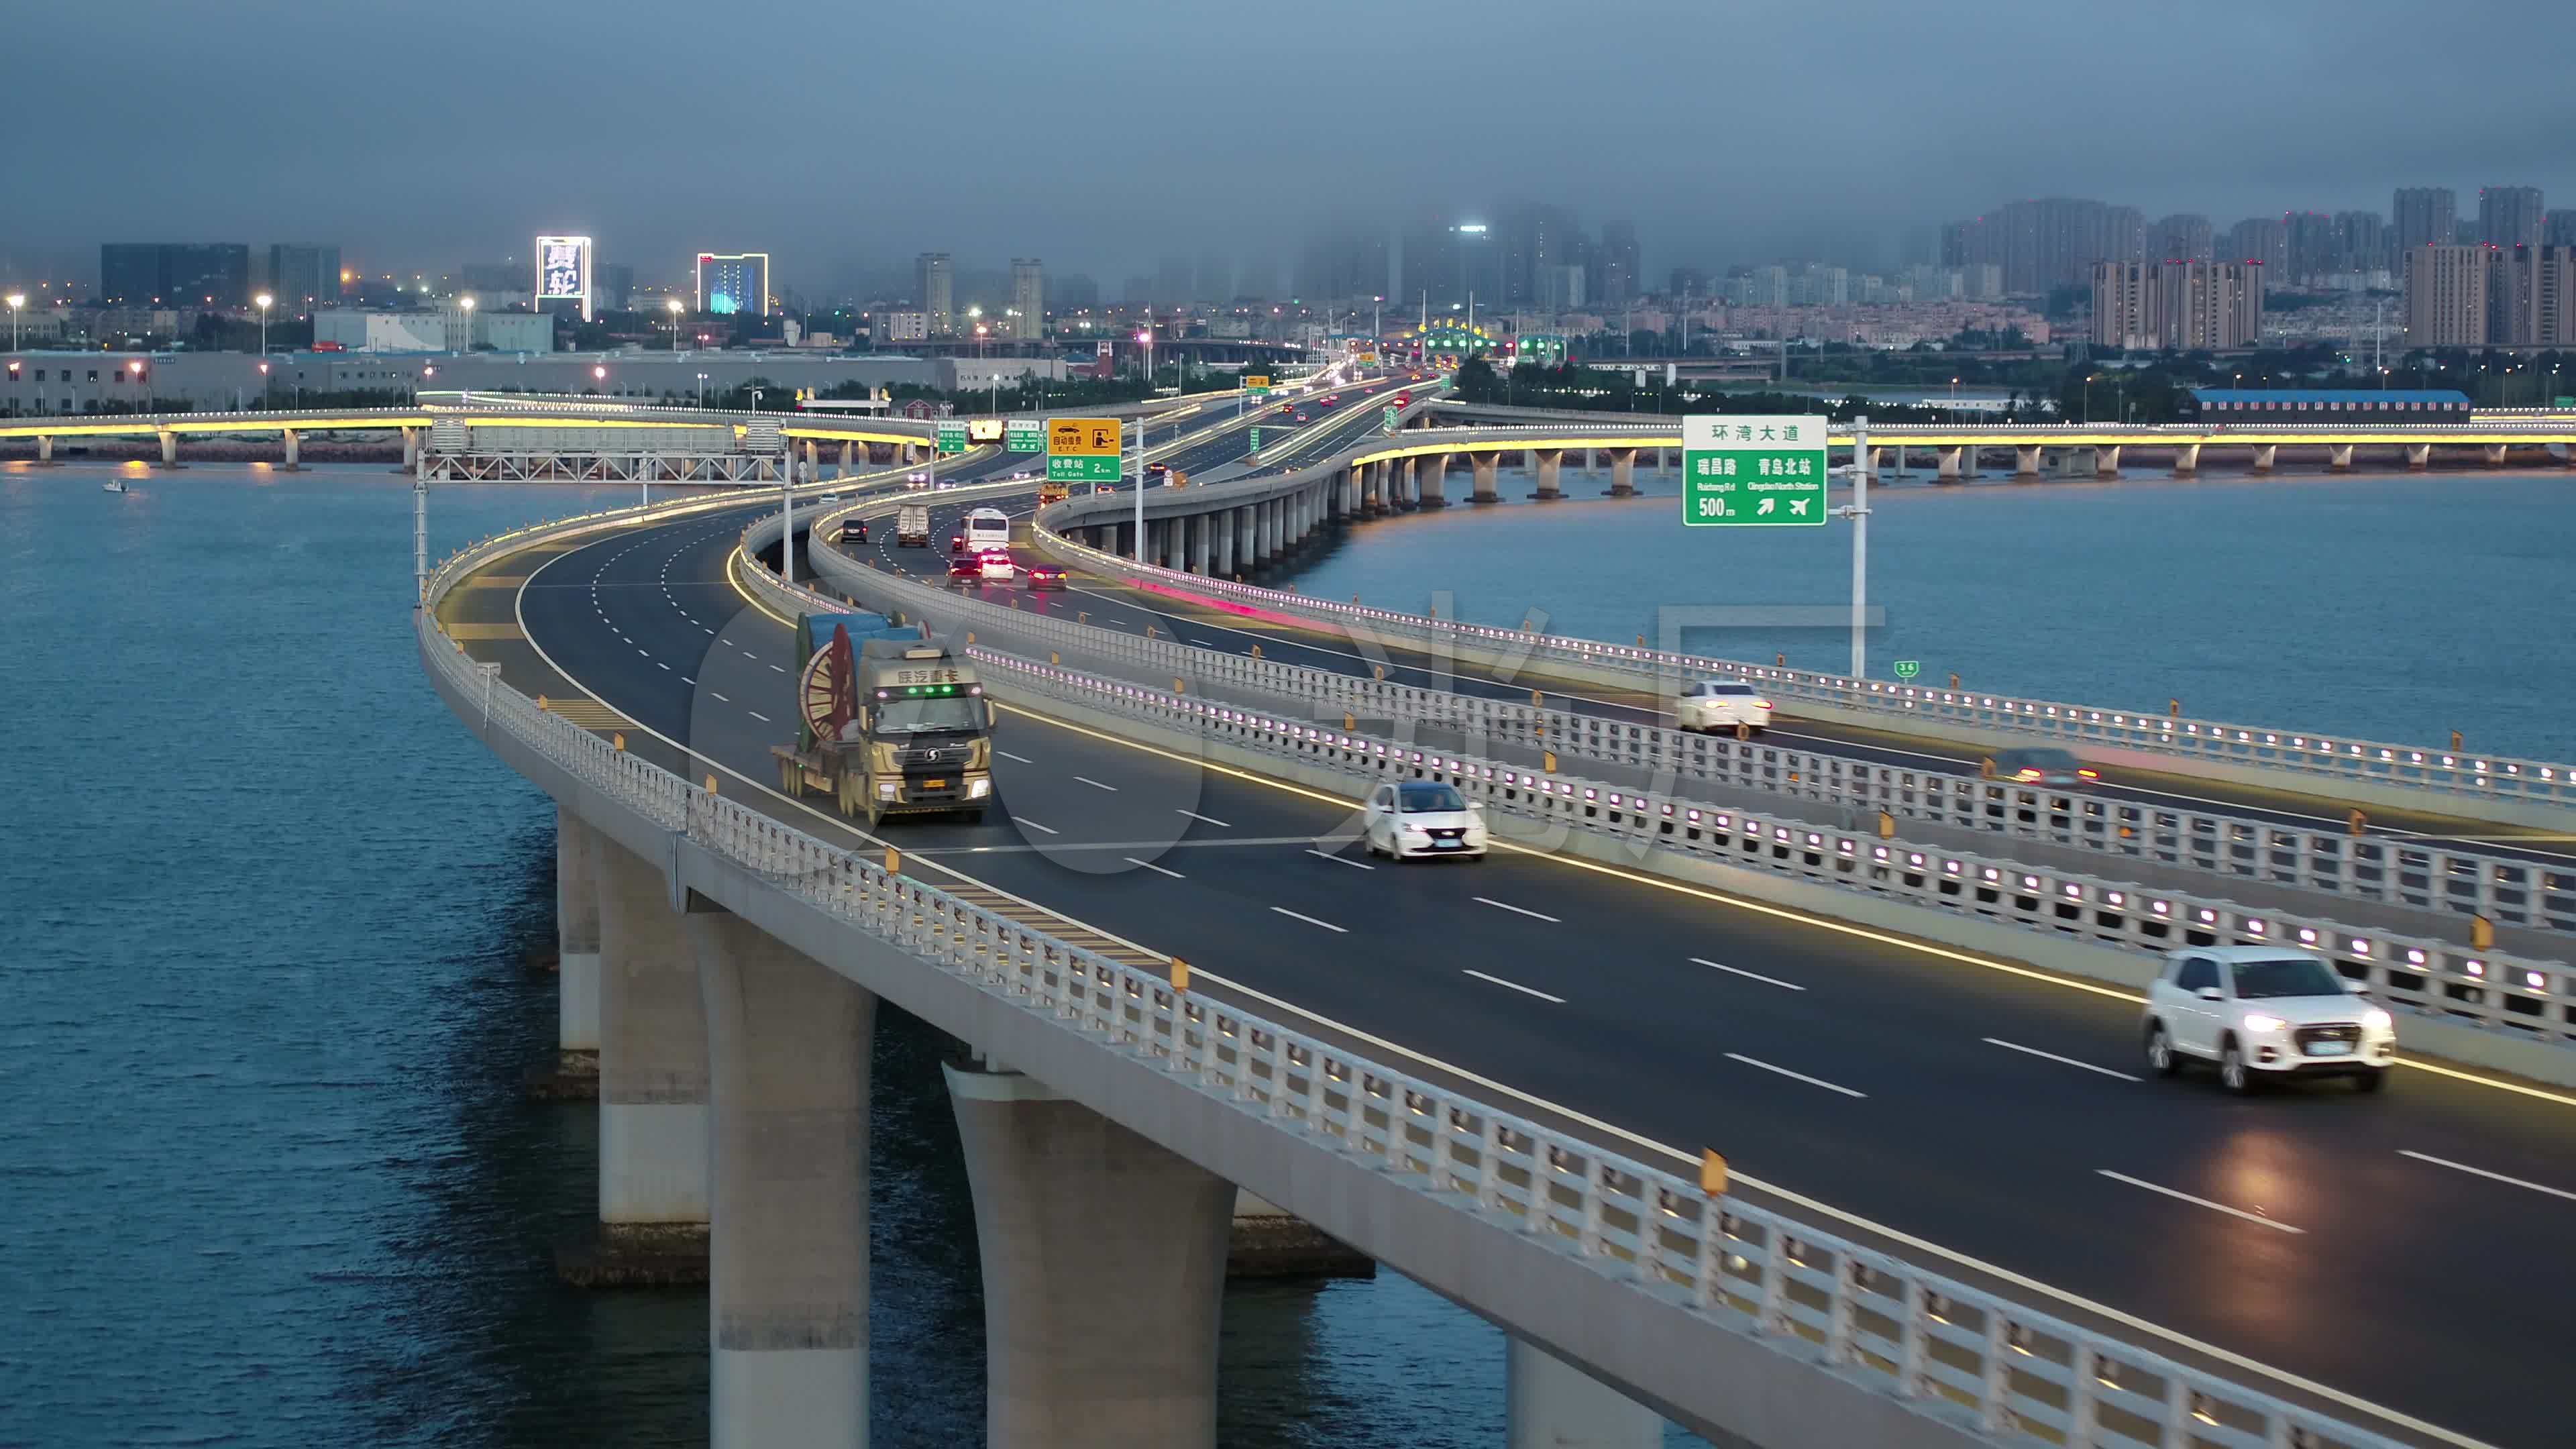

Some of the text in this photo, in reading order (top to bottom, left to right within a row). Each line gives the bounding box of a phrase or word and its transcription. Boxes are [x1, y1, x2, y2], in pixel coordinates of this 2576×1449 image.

[1711, 425, 1799, 441] 环湾大道
[1052, 459, 1084, 469] 收费站
[1697, 458, 1736, 476] 瑞昌路
[1758, 458, 1811, 476] 青岛北站
